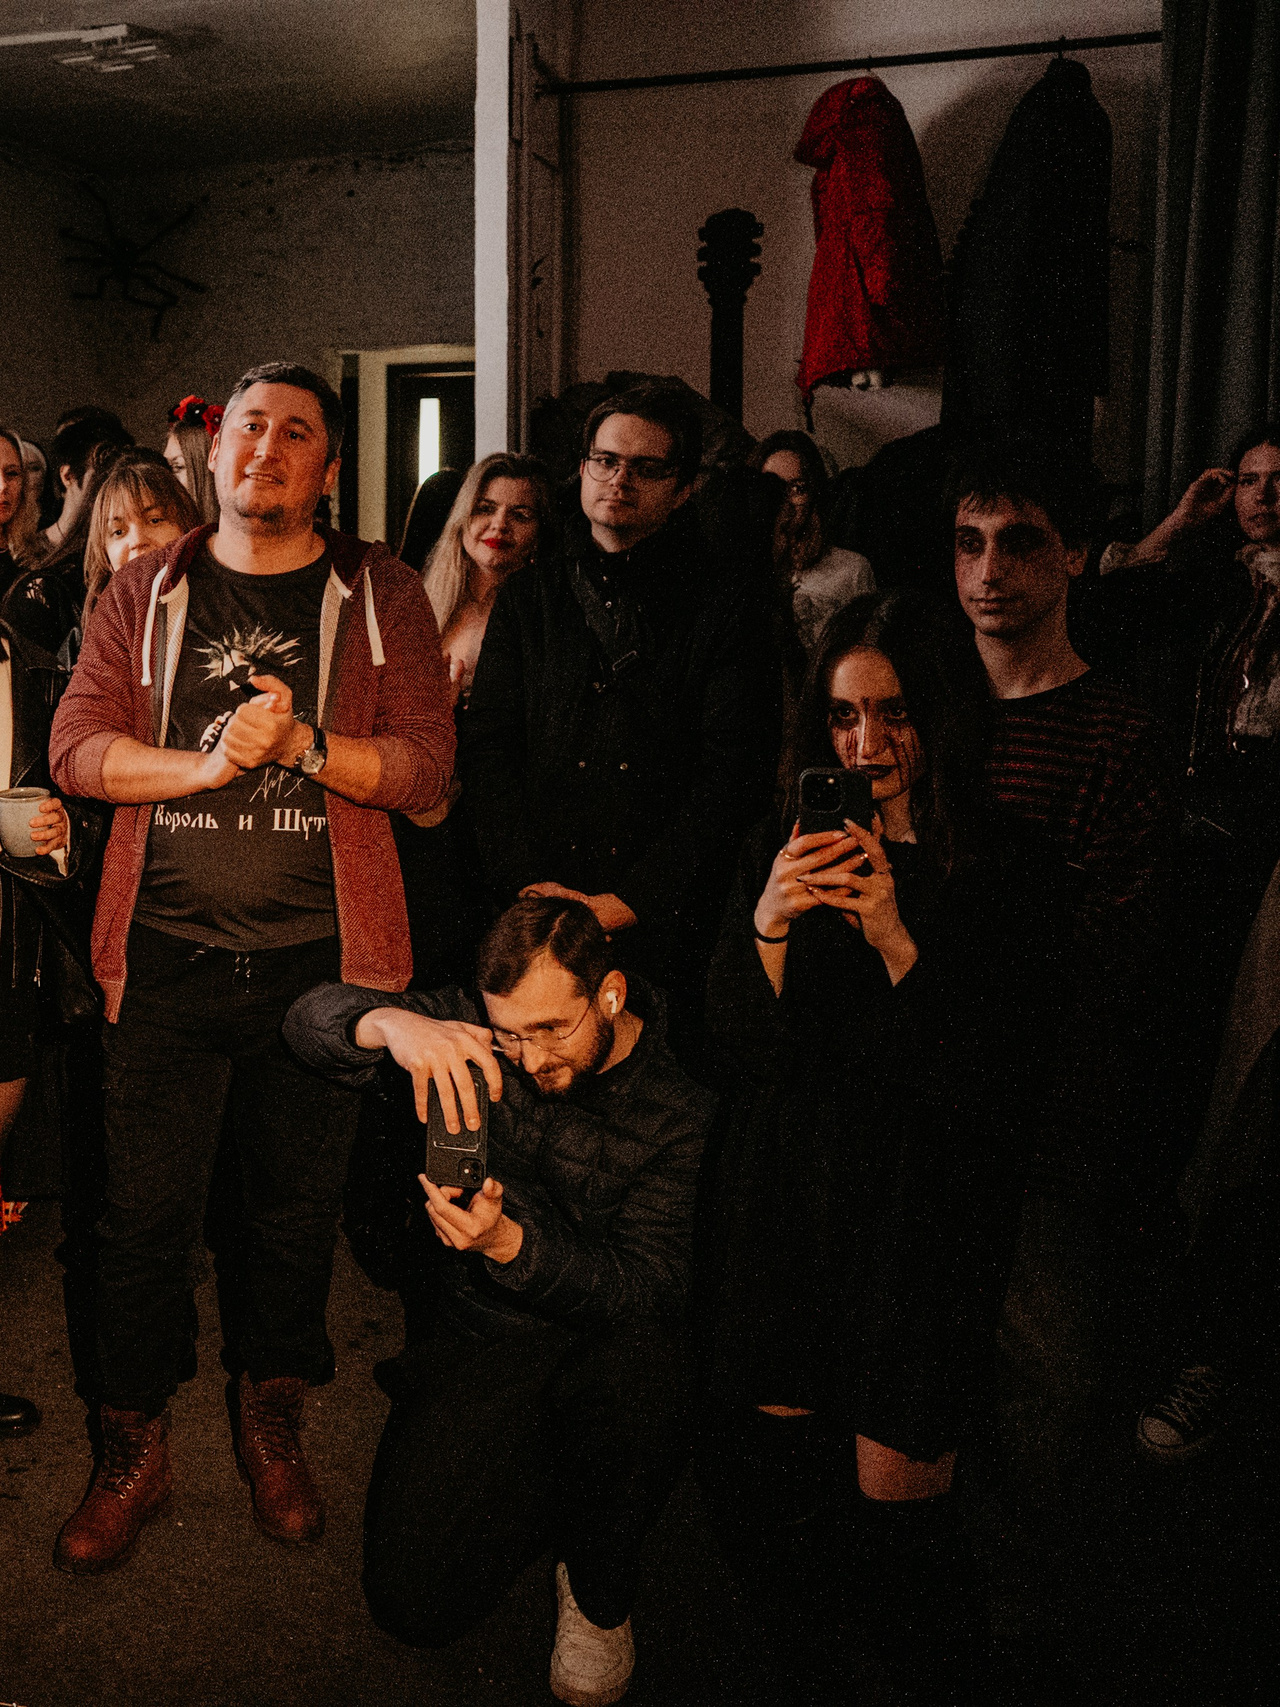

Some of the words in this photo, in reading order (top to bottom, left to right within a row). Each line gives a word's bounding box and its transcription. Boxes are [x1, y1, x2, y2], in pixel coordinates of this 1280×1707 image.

[154, 804, 219, 833] Король
[238, 814, 253, 831] и
[271, 808, 326, 841] Шут
